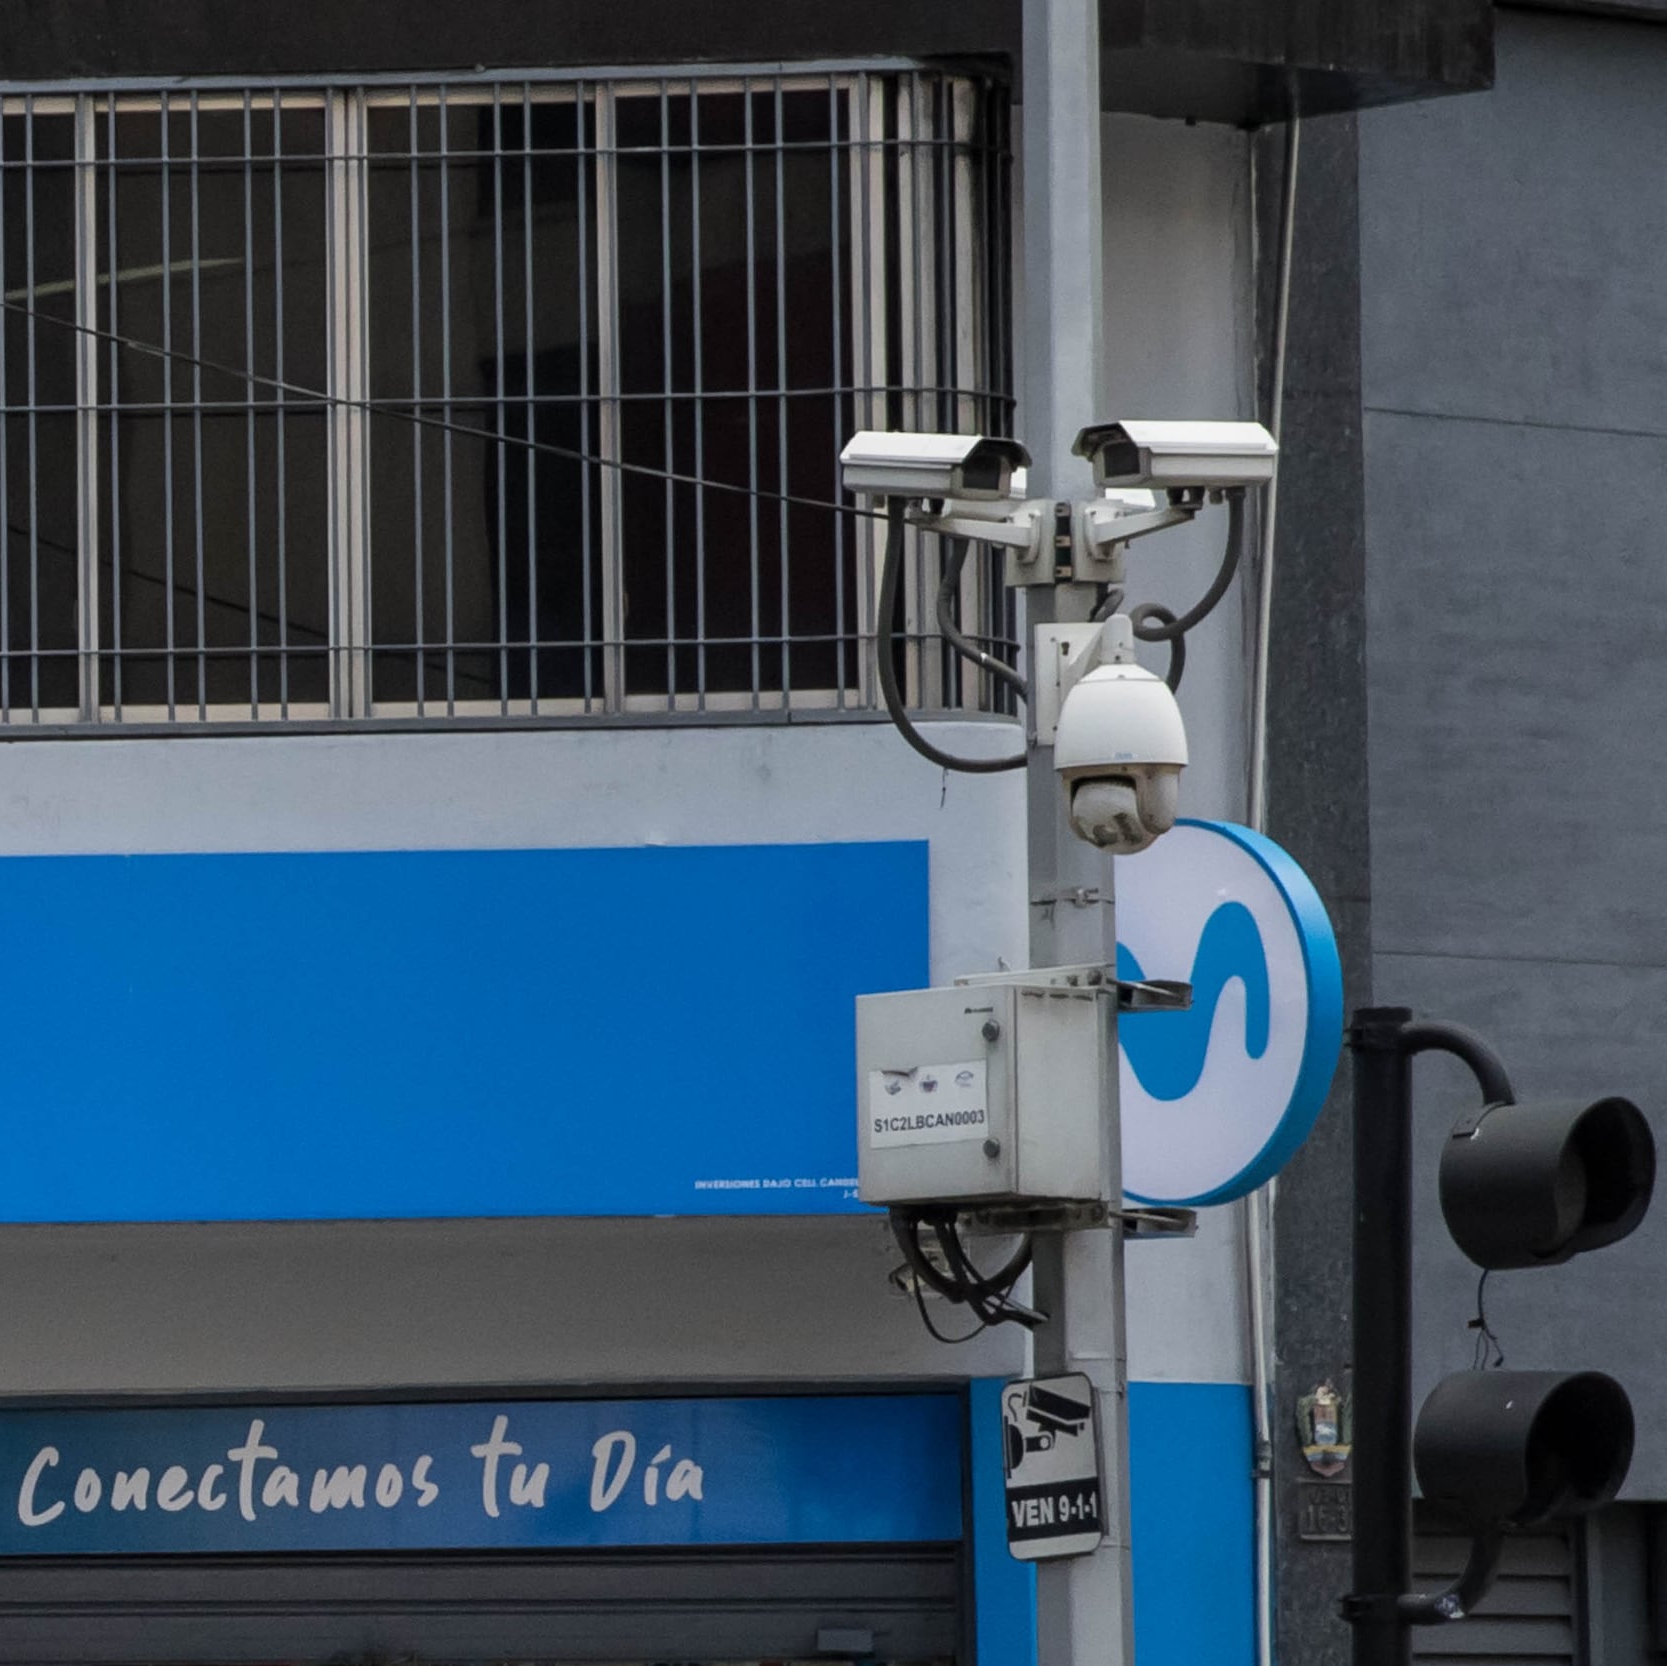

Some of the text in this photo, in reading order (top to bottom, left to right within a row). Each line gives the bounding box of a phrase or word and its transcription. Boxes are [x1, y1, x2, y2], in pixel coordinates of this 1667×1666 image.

[873, 1109, 985, 1133] S1C2LBCAN0003
[694, 1179, 760, 1189] INVERSIONES
[17, 1415, 705, 1527] Conectamos tu Día
[1011, 1491, 1098, 1528] VEN 9-1-1
